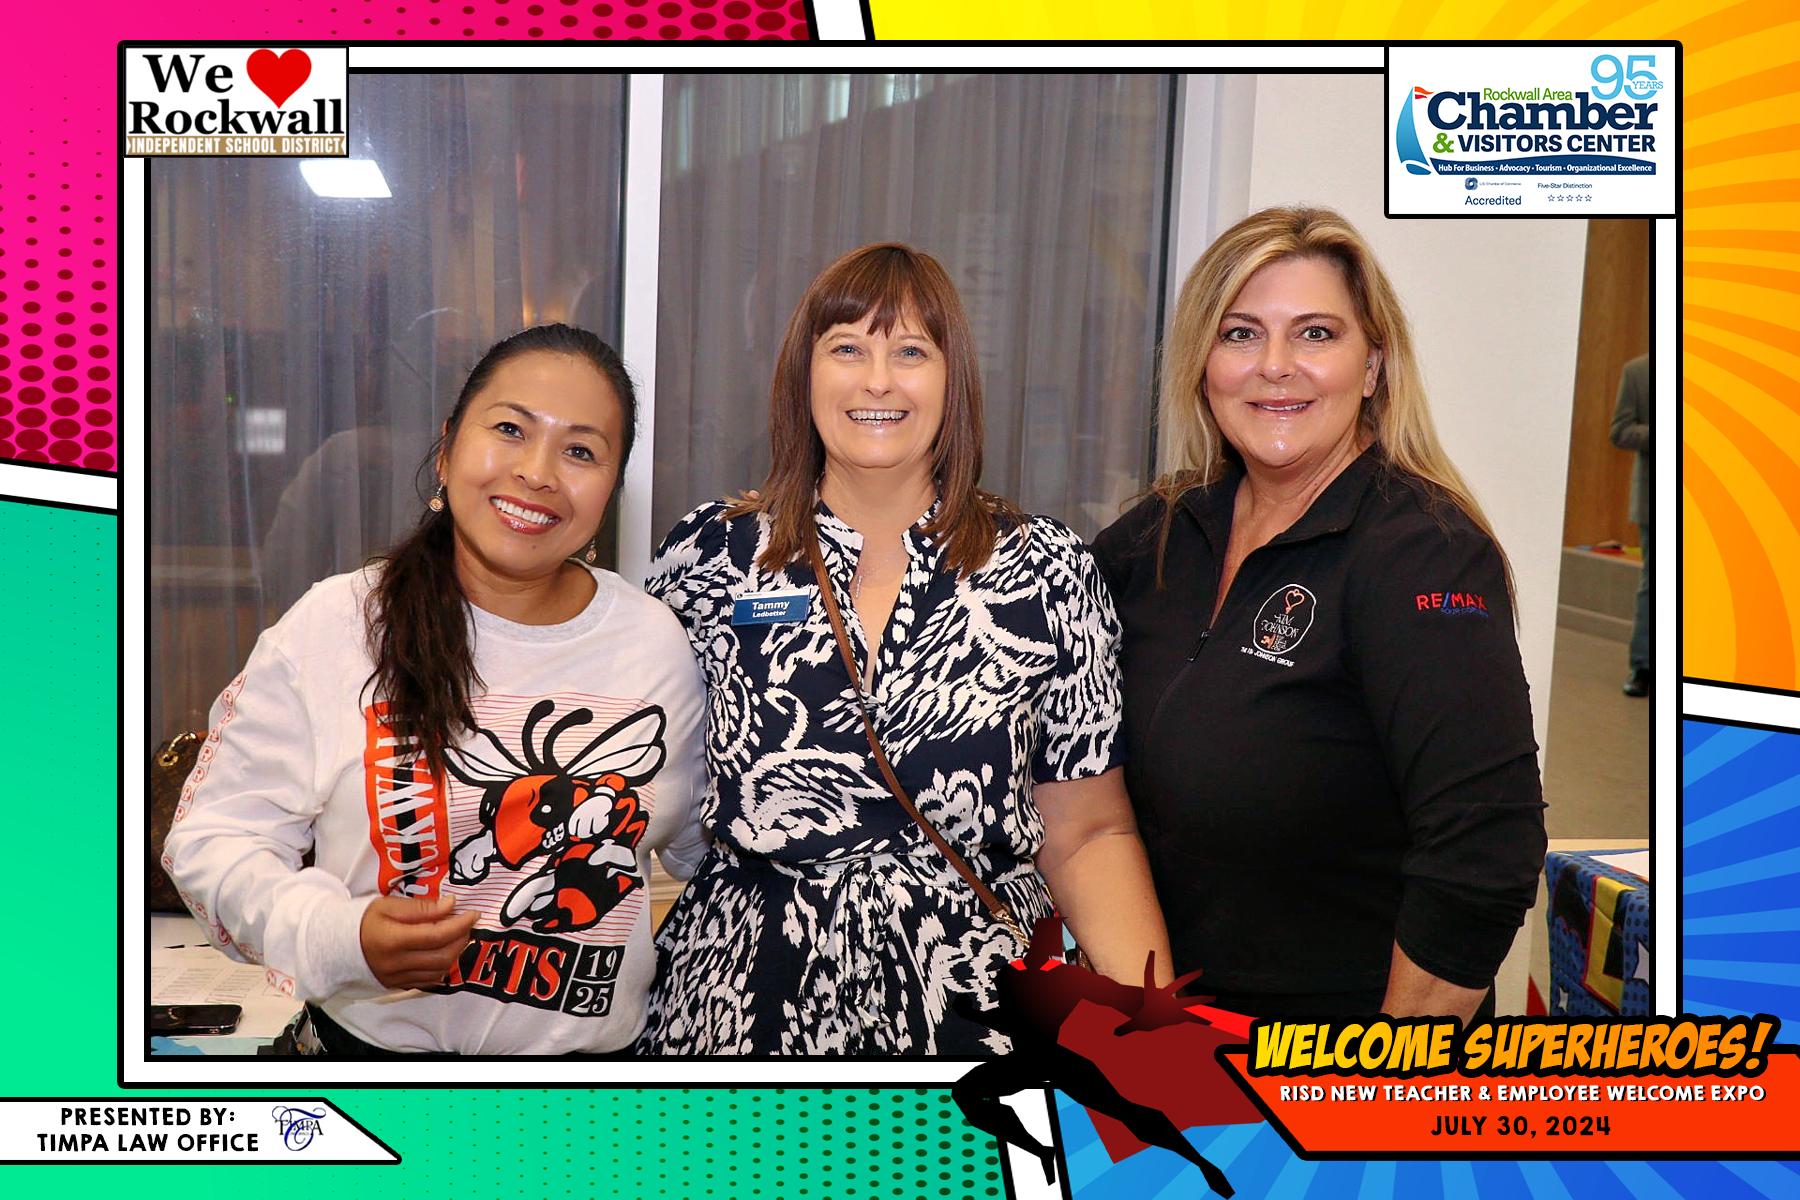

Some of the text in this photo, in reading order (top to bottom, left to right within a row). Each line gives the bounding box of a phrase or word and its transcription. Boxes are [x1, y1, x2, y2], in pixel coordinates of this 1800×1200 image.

[752, 601, 790, 610] Tammy
[1415, 592, 1488, 610] RE/MAX
[586, 949, 618, 978] 19
[571, 986, 610, 1014] 25
